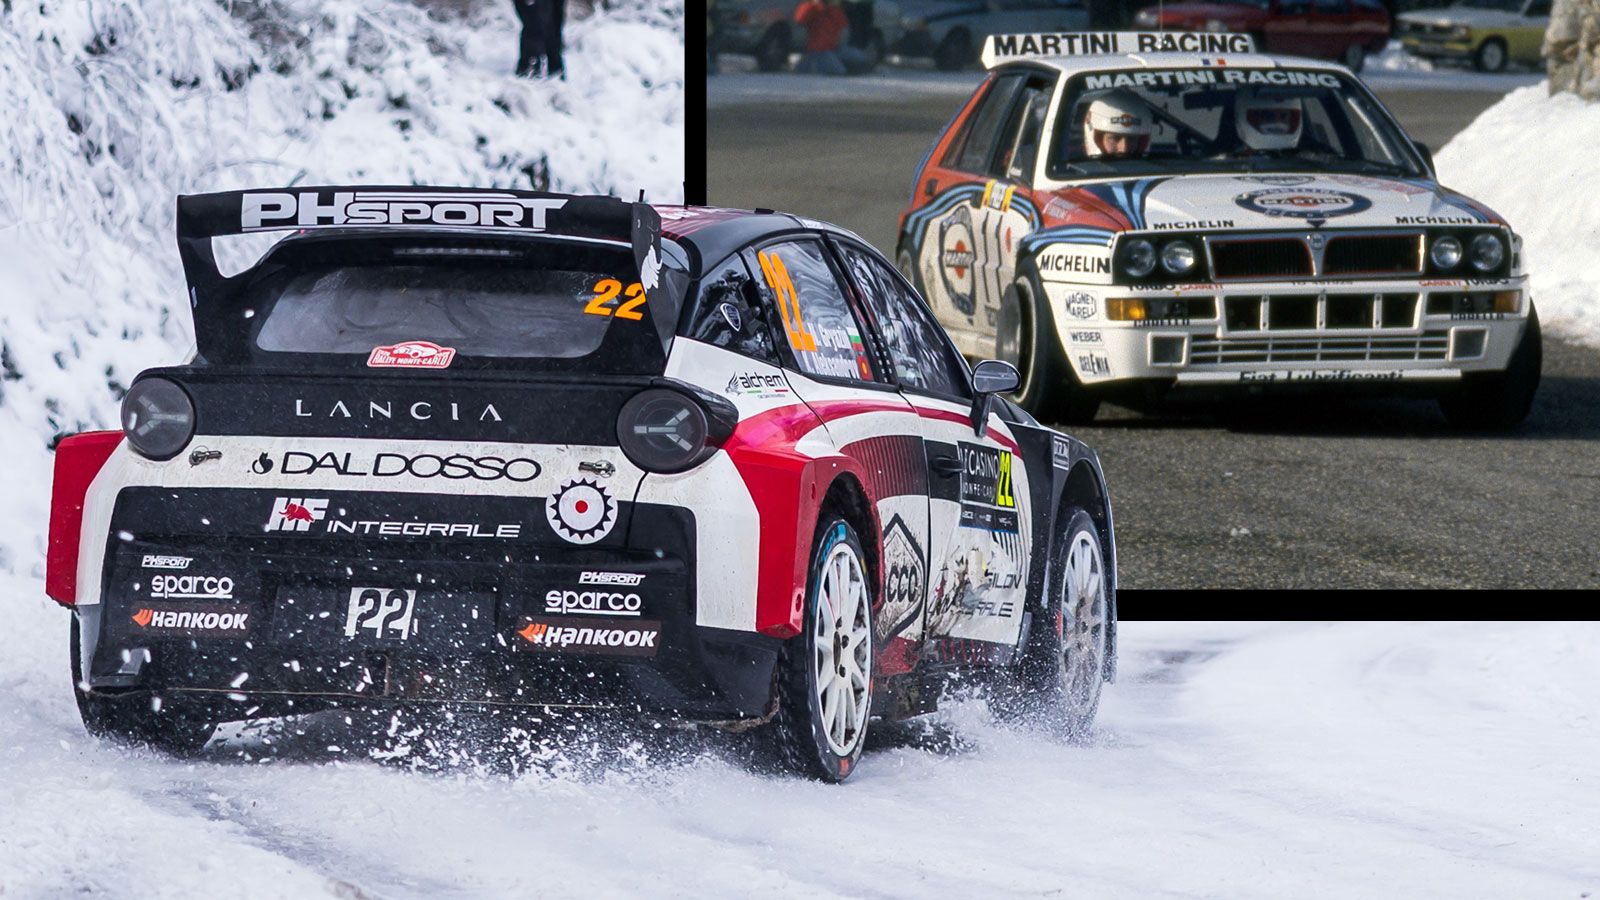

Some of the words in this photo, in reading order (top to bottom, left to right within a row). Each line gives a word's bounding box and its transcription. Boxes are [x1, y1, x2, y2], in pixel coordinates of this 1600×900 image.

[994, 32, 1119, 56] MARTINI
[1138, 32, 1250, 53] RACING
[1086, 69, 1217, 90] MARTINI
[1225, 70, 1341, 88] RACING
[1153, 220, 1234, 230] MICHELIN
[1395, 216, 1472, 224] MICHELIN
[1040, 254, 1111, 273] MICHELIN
[583, 278, 647, 320] 22
[1070, 332, 1102, 342] WEBER
[739, 371, 786, 388] alchem
[1240, 370, 1277, 381] Fiat
[295, 399, 502, 421] LANCIA
[279, 451, 367, 476] DAL
[372, 453, 542, 482] DOSSO
[969, 449, 999, 480] CASINO
[327, 520, 521, 538] INTEGRALE
[151, 575, 234, 599] sparco
[545, 590, 641, 615] sparco
[354, 588, 409, 639] 22
